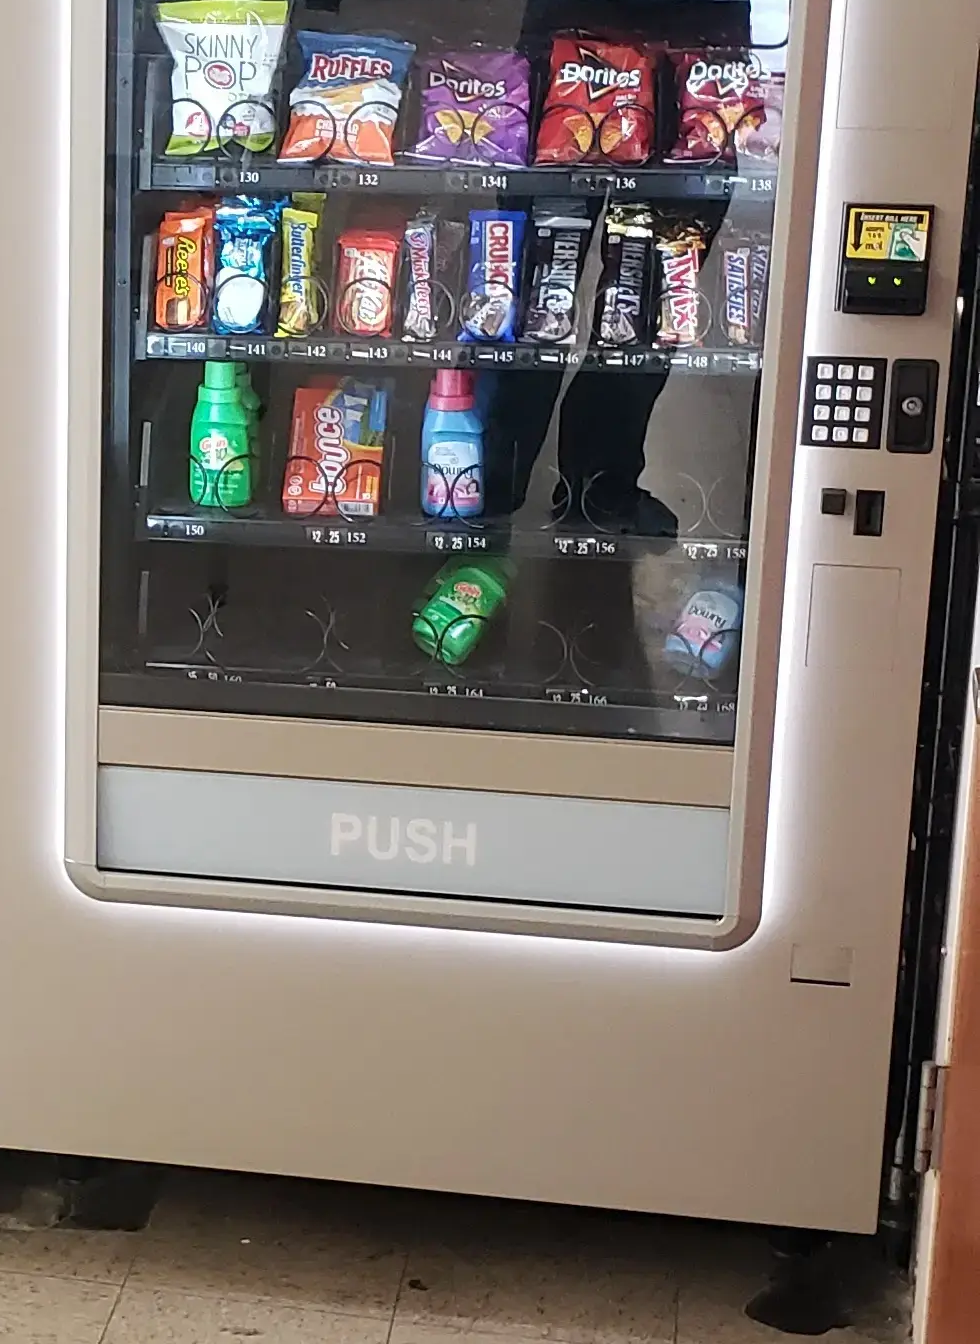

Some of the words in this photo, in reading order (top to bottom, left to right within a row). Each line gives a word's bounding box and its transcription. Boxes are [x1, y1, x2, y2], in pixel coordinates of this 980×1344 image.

[185, 33, 258, 59] SKINNY
[185, 55, 257, 91] POP
[310, 54, 392, 82] RUFFLES
[562, 62, 640, 88] Doritos
[429, 71, 506, 98] Doritos
[239, 172, 259, 183] 130
[358, 174, 378, 185] 132
[616, 177, 636, 189] 136
[751, 179, 771, 190] 138
[489, 222, 509, 299] CRUNC
[186, 342, 206, 353] 140
[247, 344, 266, 355] 141
[307, 346, 326, 357] 142
[369, 348, 388, 359] 143
[432, 349, 452, 360] 144
[493, 351, 513, 362] 145
[559, 353, 579, 364] 146
[624, 355, 644, 366] 147
[687, 356, 708, 367] 148
[201, 439, 227, 451] Gin
[185, 525, 204, 536] 150
[347, 532, 366, 544] 152
[467, 537, 486, 548] 154
[595, 542, 615, 554] 156
[726, 547, 746, 558] 158
[330, 812, 477, 867] PUSH
